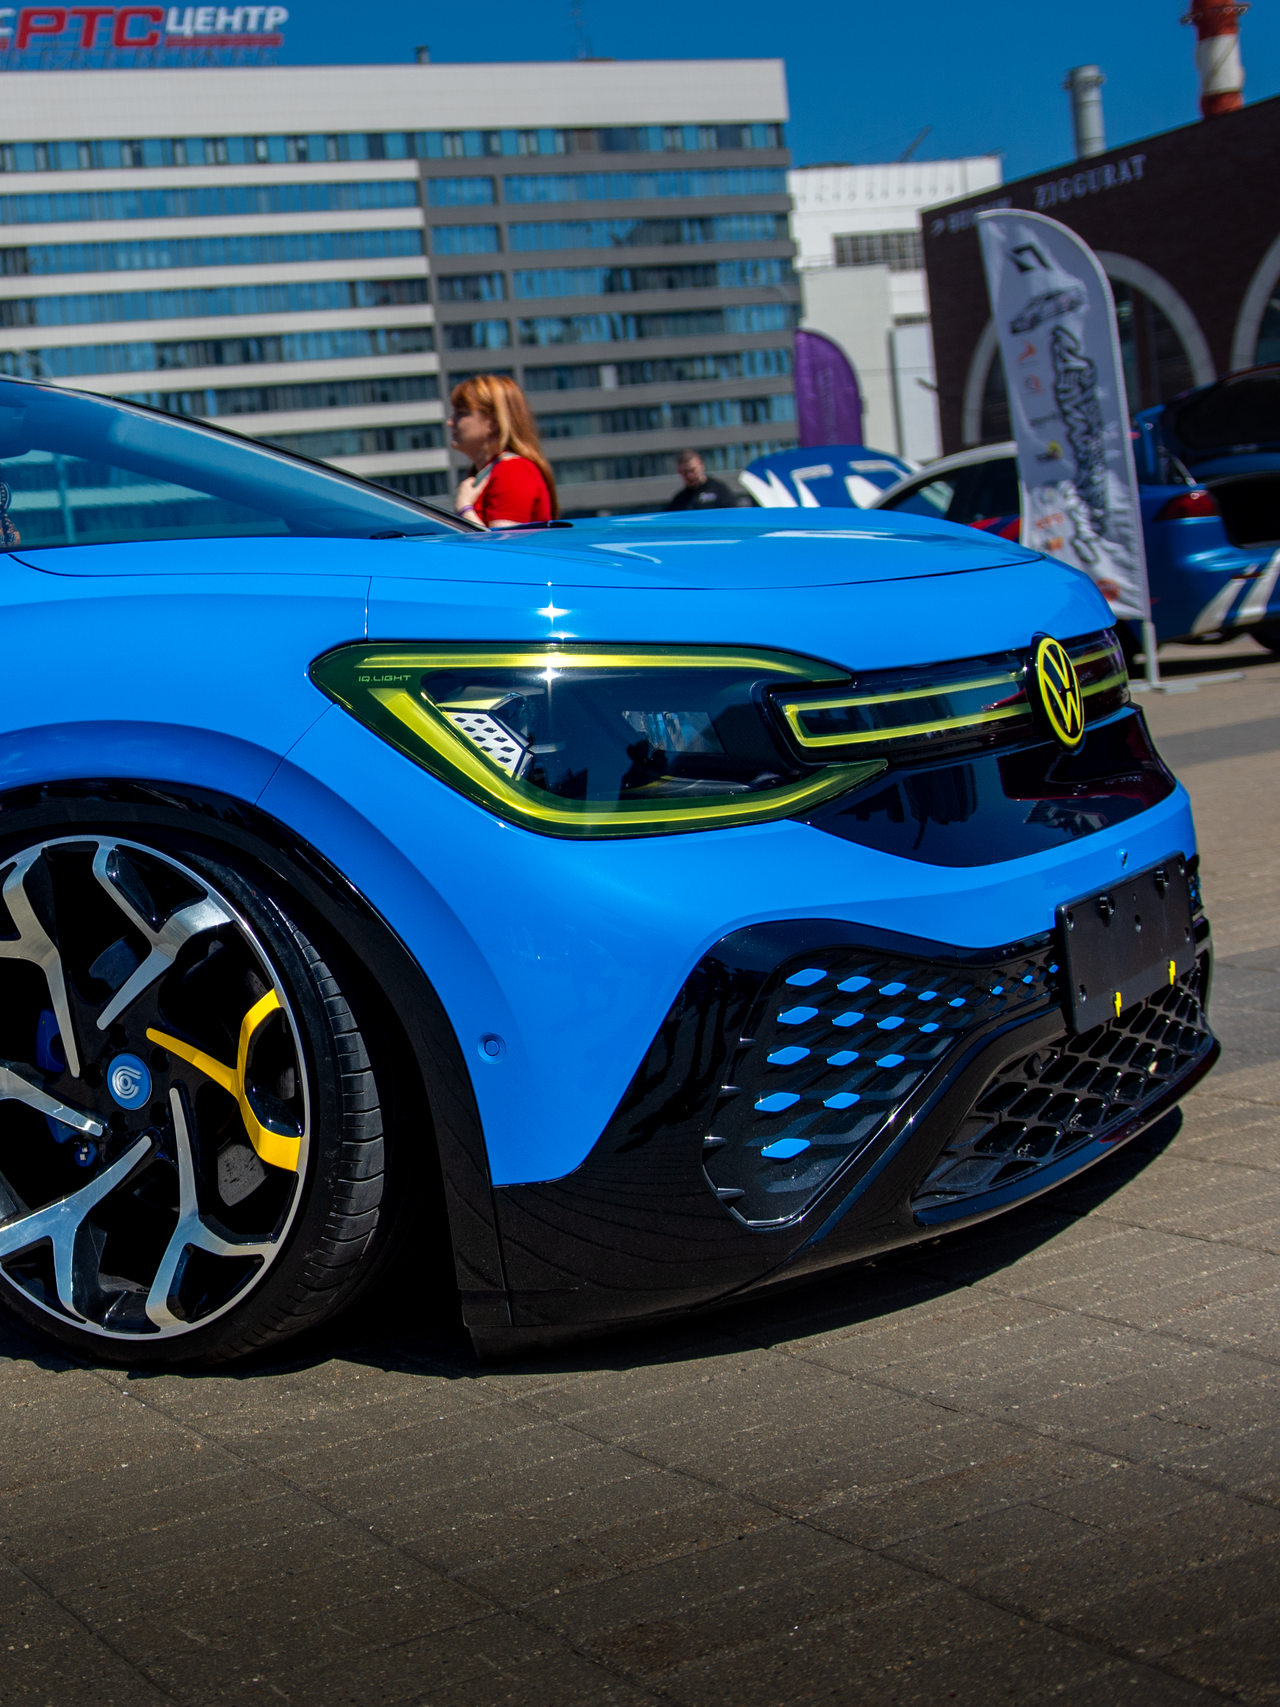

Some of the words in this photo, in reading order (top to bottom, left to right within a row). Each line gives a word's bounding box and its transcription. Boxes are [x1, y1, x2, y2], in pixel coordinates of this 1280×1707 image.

[17, 7, 164, 50] РТС
[165, 6, 289, 39] ЦЕНТР
[358, 674, 412, 682] IQ.LIGHT
